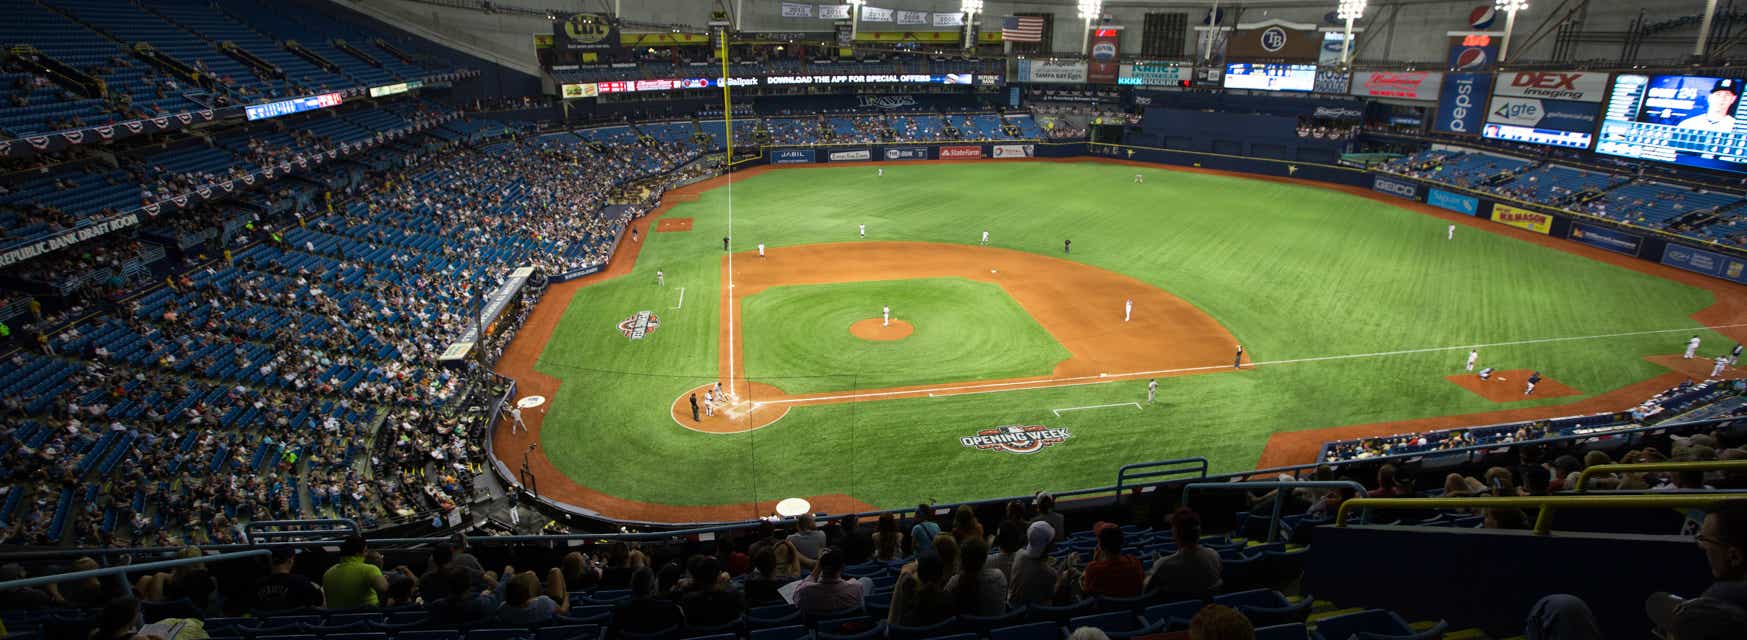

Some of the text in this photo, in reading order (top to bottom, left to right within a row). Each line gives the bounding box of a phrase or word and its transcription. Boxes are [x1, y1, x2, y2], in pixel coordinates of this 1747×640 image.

[767, 76, 813, 84] DOWNLOAD
[831, 75, 848, 83] APP
[848, 75, 866, 83] FOR
[866, 74, 899, 83] SPECIAL
[900, 74, 930, 82] OFFERS
[1511, 71, 1582, 90] DEX
[1523, 87, 1585, 99] imaging
[1450, 78, 1473, 132] pepsi
[1510, 104, 1537, 117] gte
[1375, 179, 1414, 196] GEICO
[0, 214, 139, 266] REPUBLIC BANK DRAFT ROOM
[961, 428, 1070, 447] OPENING WEEK
